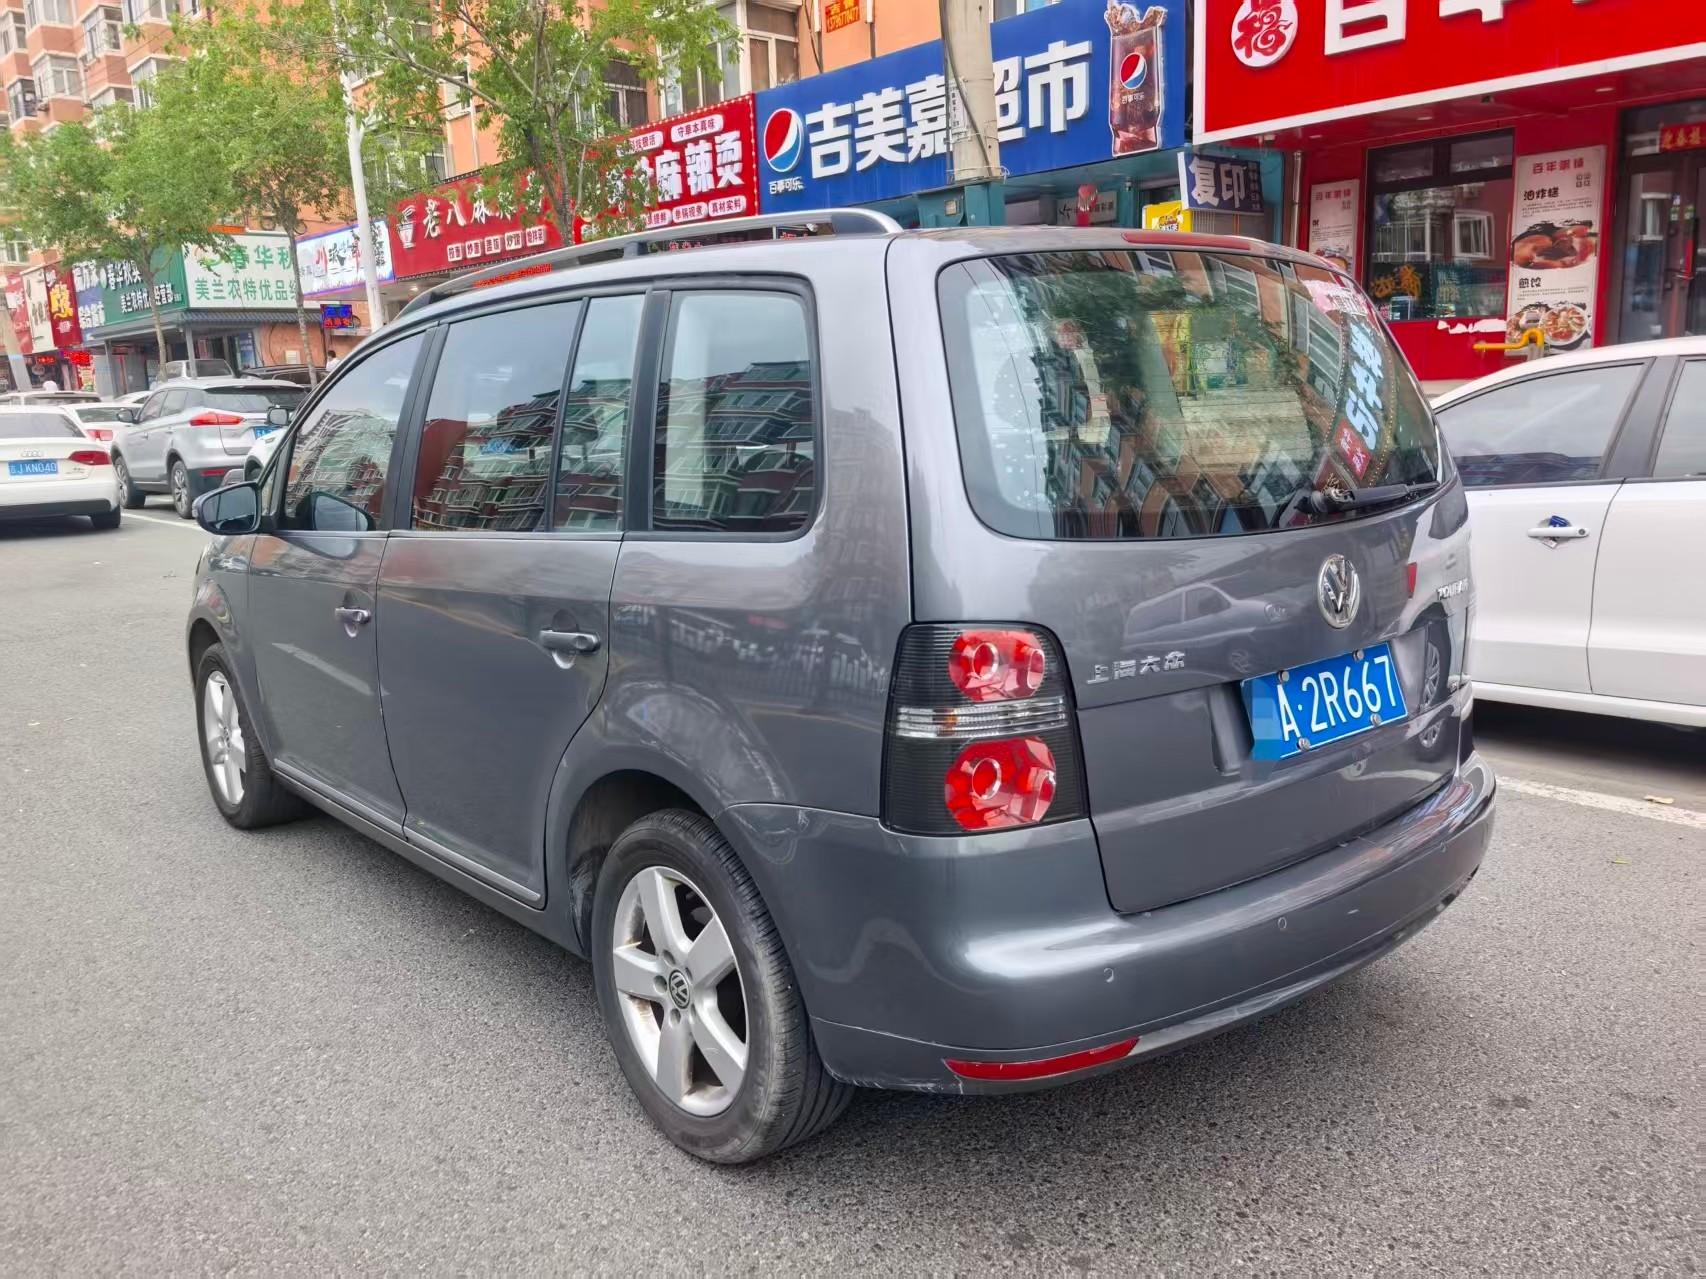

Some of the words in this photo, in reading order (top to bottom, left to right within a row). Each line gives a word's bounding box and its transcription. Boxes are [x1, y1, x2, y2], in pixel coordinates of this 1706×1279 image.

[768, 176, 804, 195] 百事可乐
[1188, 156, 1245, 208] 复印
[712, 198, 741, 214] 真材实料
[121, 282, 174, 313] 美兰农特优经营部
[1086, 651, 1185, 685] 上海大众
